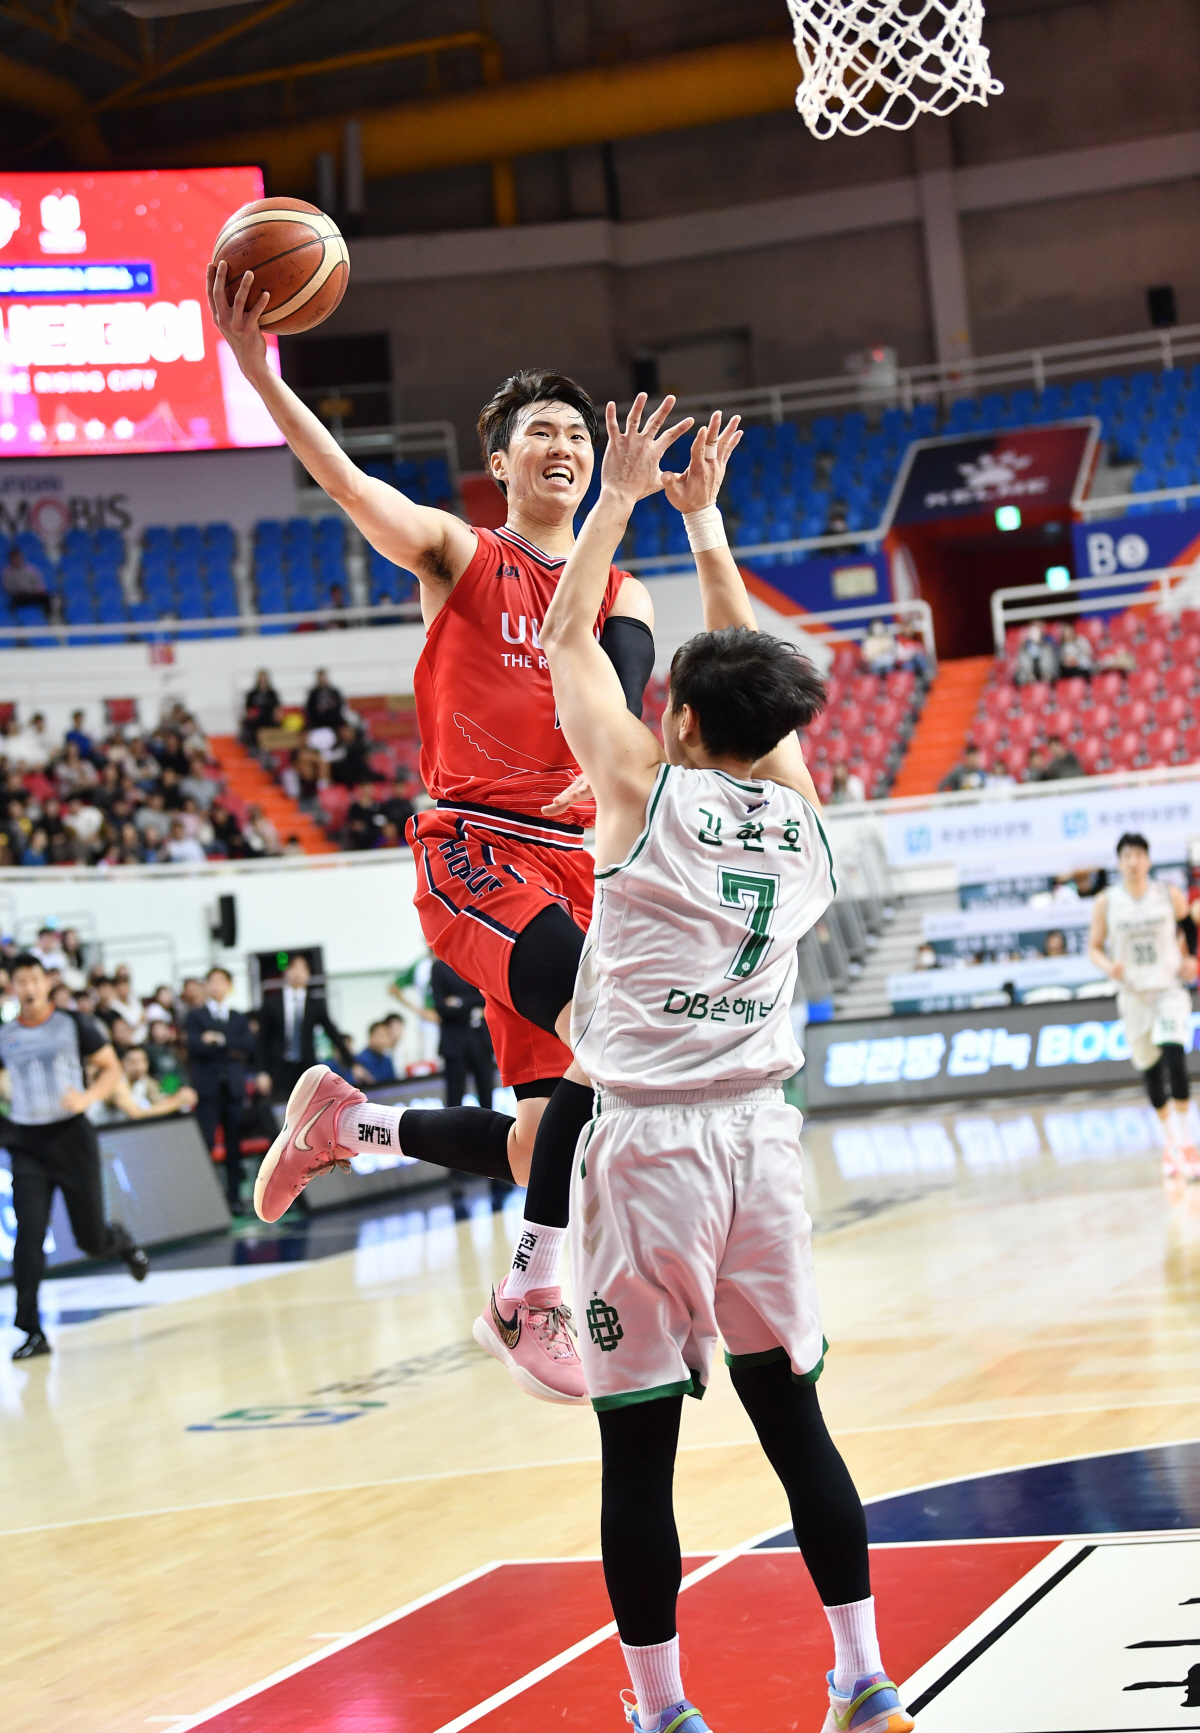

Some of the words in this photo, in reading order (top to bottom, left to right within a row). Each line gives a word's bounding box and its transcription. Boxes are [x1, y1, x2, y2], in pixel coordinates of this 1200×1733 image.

[501, 653, 532, 668] THE
[718, 865, 780, 981] 7
[358, 1124, 391, 1147] KELME
[512, 1230, 539, 1272] KELME
